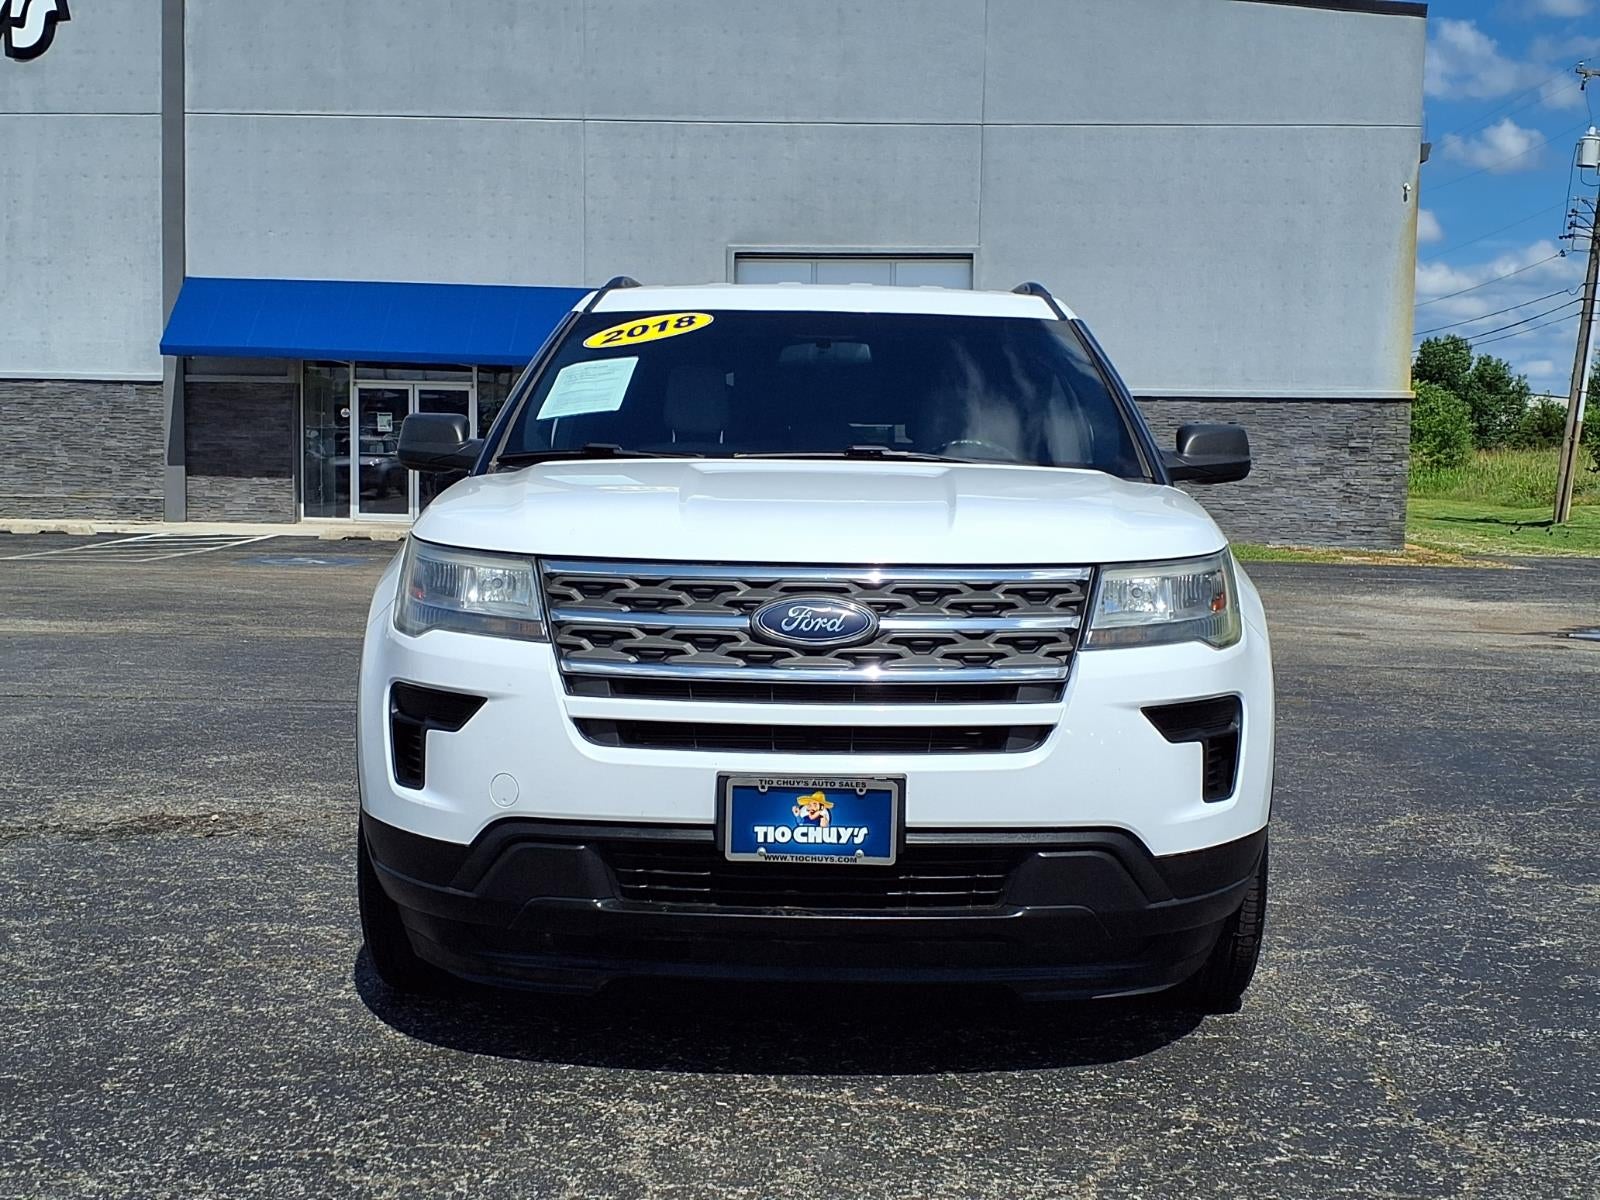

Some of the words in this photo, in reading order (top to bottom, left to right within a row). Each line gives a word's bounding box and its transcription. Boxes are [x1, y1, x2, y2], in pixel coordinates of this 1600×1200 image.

[600, 315, 697, 345] 2018
[781, 605, 845, 632] Ford
[776, 779, 809, 787] CHUY'S
[811, 780, 836, 788] AUTO
[838, 781, 867, 789] SALES
[764, 854, 858, 864] WWW.TIOCHUYS.COM
